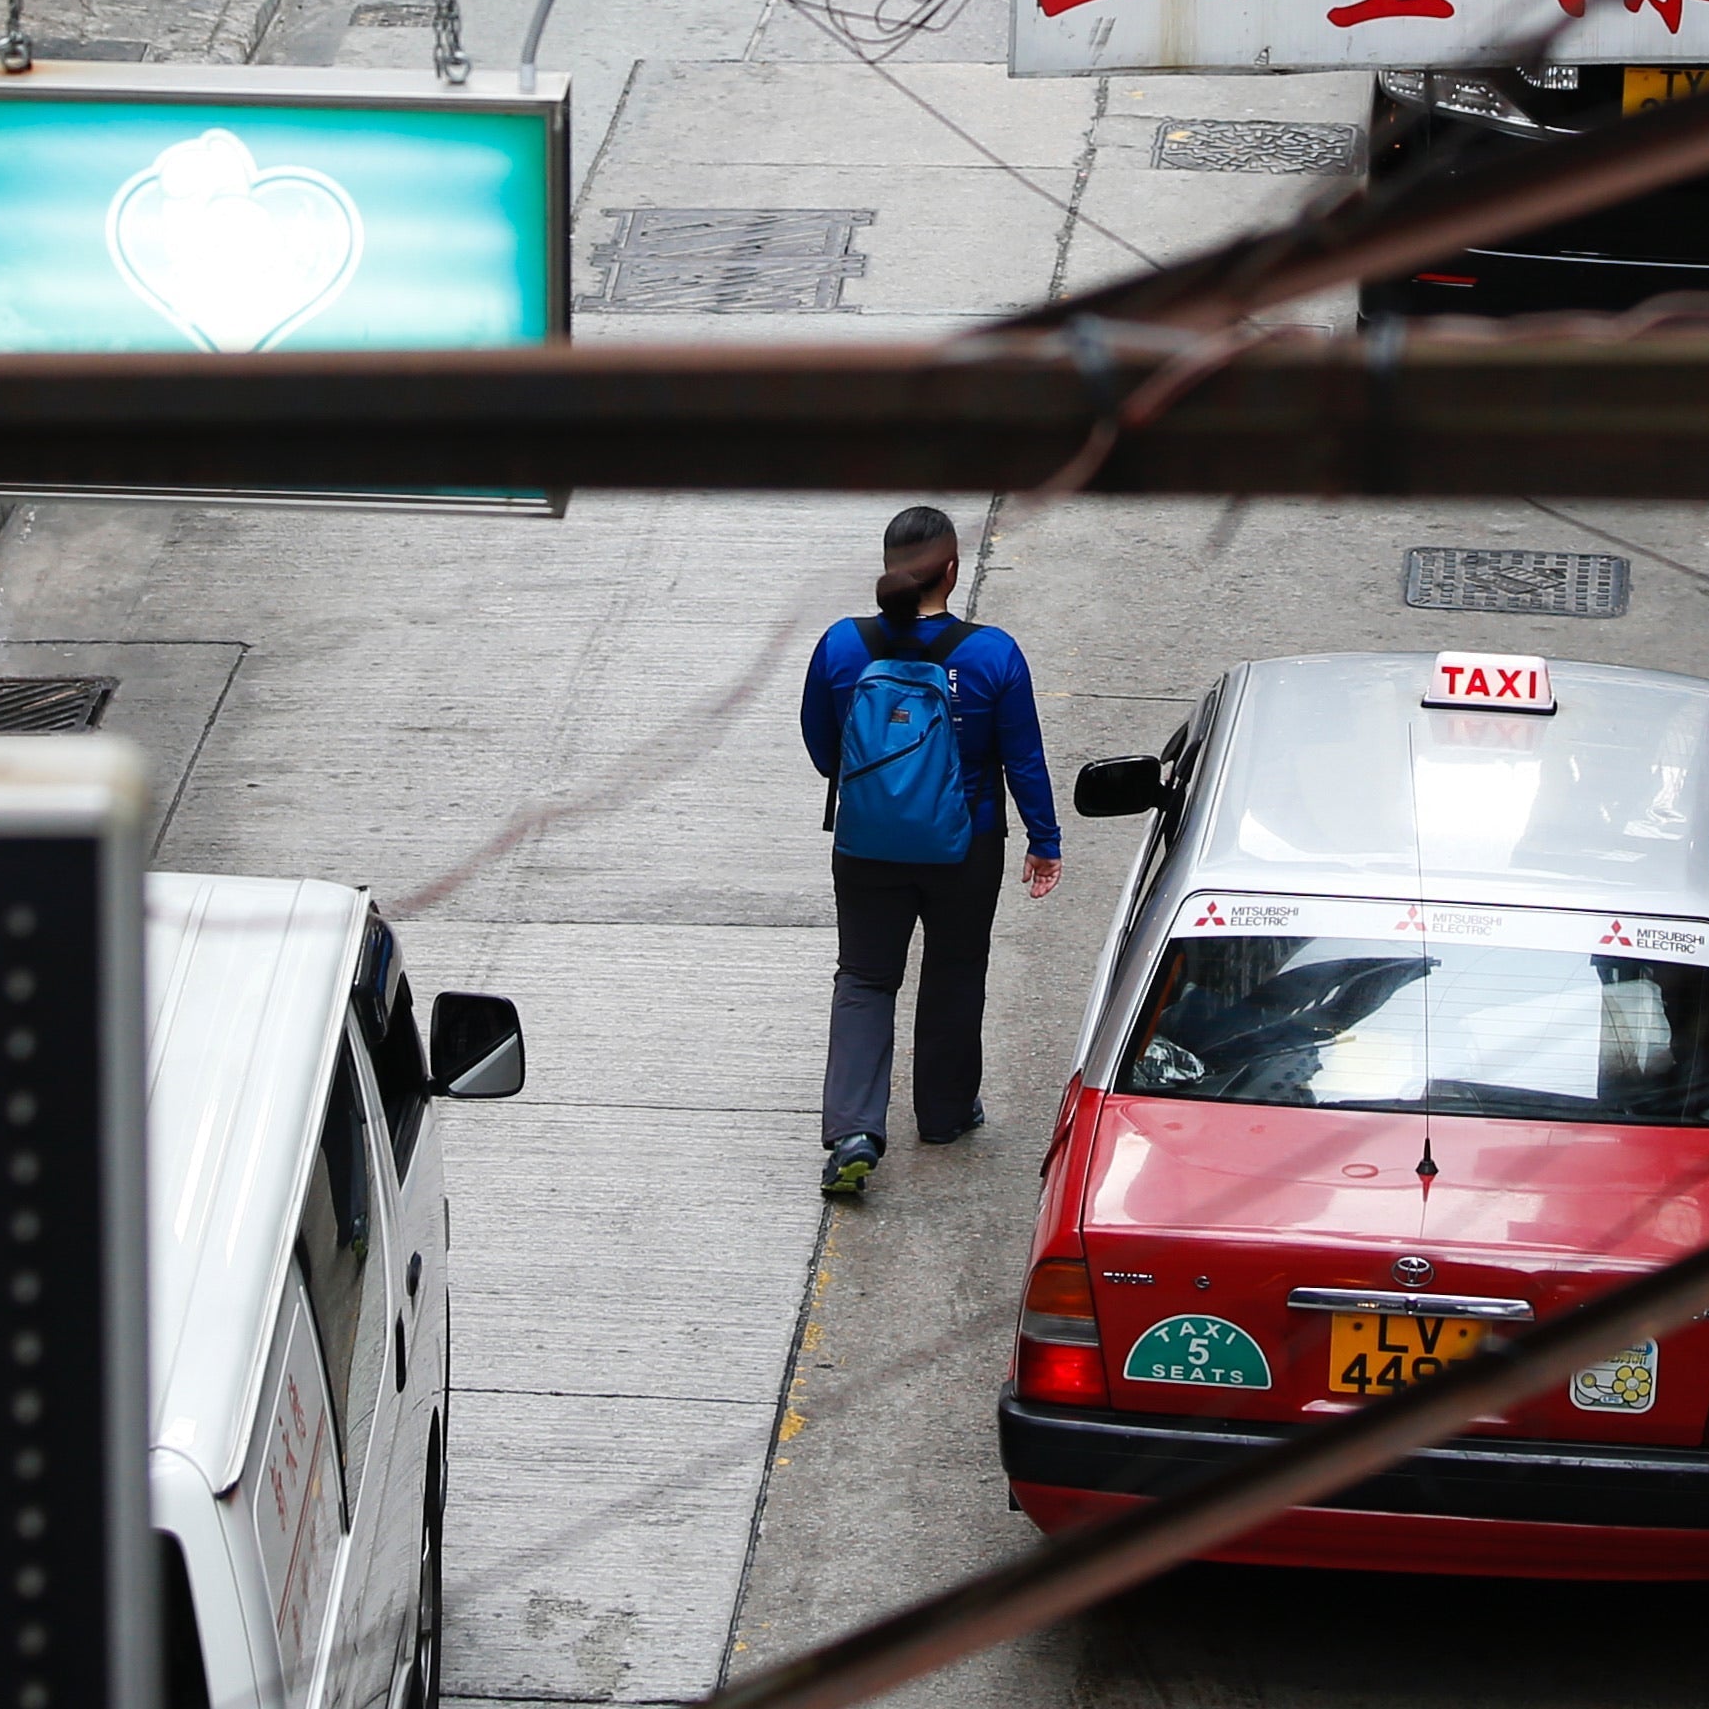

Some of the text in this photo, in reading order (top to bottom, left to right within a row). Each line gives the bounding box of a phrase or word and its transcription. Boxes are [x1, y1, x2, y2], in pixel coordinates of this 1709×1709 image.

[1441, 666, 1539, 700] TAXI
[1231, 905, 1300, 918] MITSUBISHI
[1432, 912, 1503, 926] MITSUBISHI
[1229, 916, 1290, 927] ELECTRIC
[1431, 923, 1493, 937] ELECTRIC
[1636, 928, 1706, 944] MITSUBISHI
[1636, 939, 1696, 954] ELECTRIC
[1154, 1320, 1237, 1346] TAXI
[1378, 1314, 1445, 1354] LV
[1187, 1338, 1210, 1366] 5
[1151, 1363, 1244, 1385] SEATS
